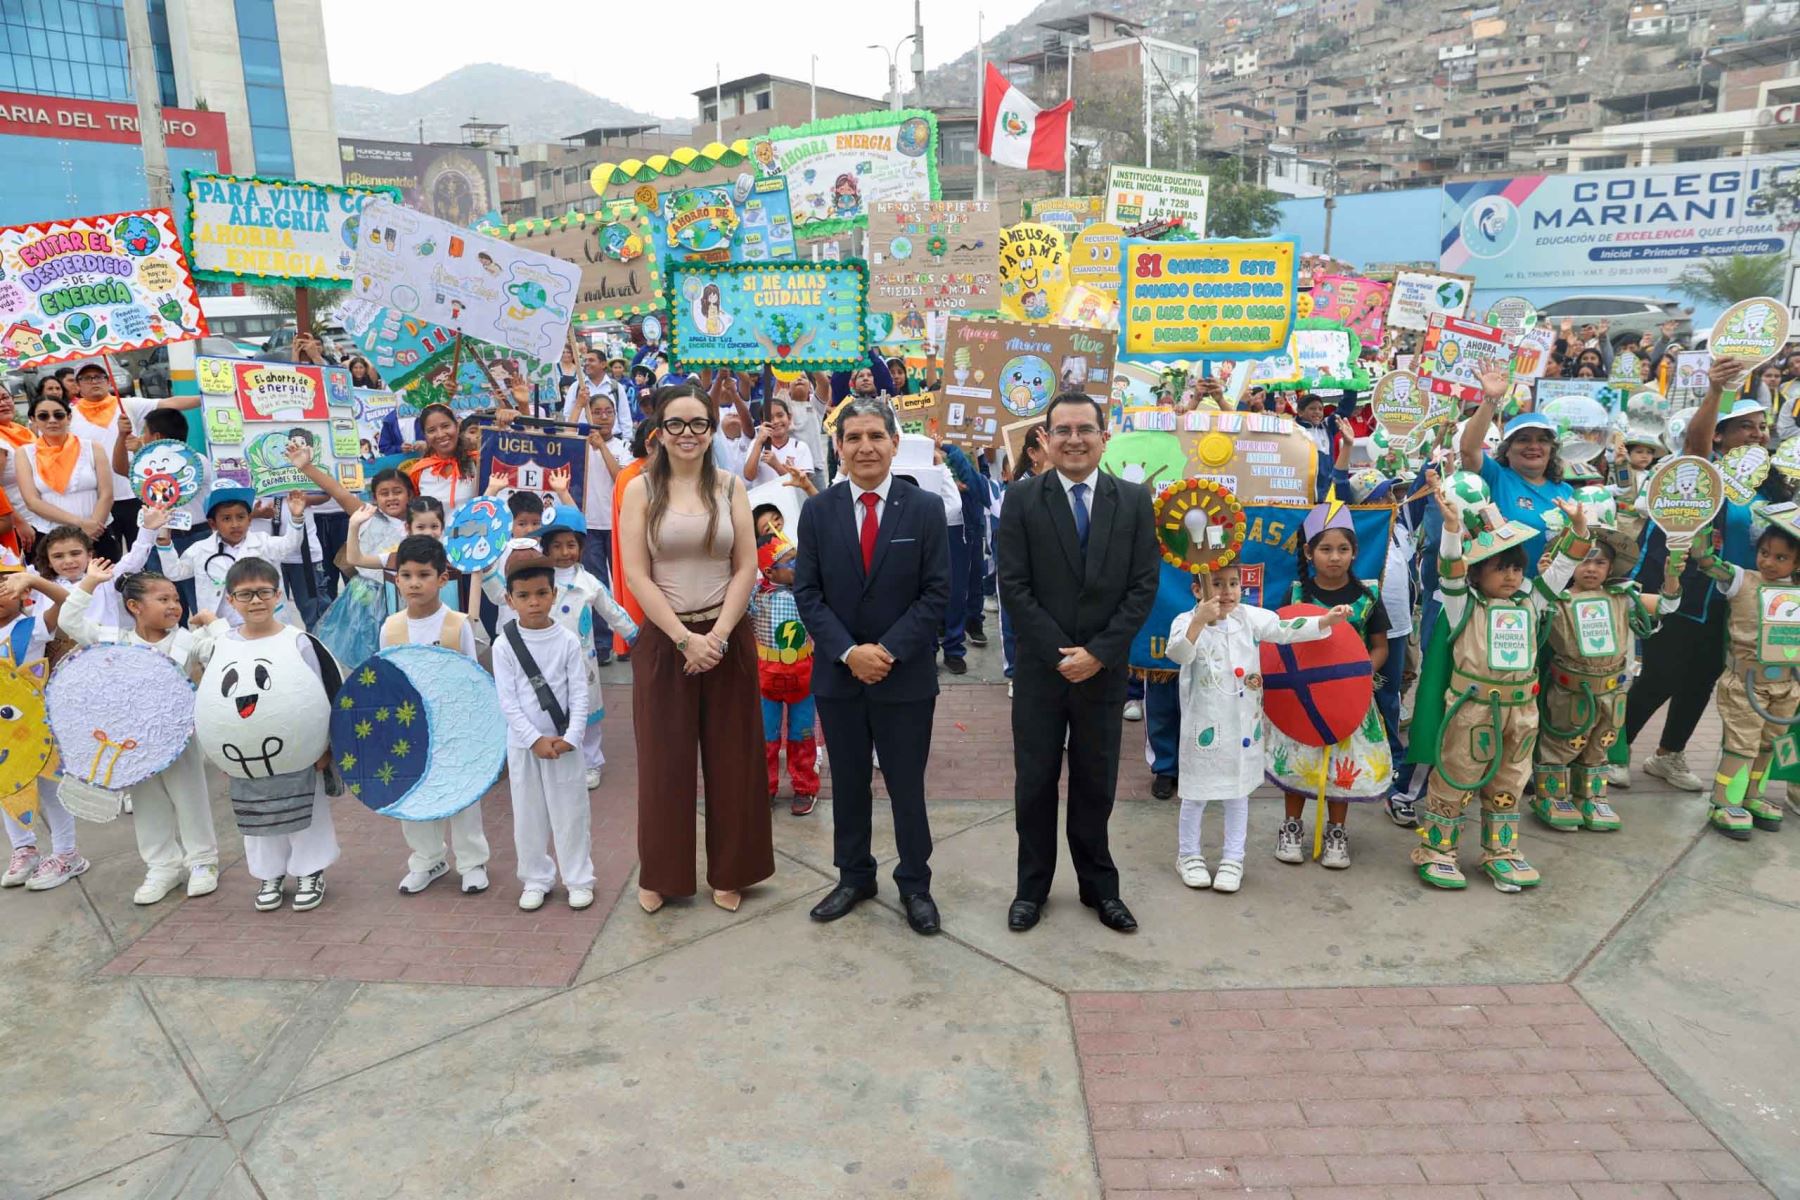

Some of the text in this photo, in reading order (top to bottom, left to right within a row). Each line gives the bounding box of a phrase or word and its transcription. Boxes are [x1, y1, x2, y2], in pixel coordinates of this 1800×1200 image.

[57, 110, 101, 129] DEL
[780, 139, 829, 171] AHORRA
[835, 134, 893, 151] ENERGIA
[767, 166, 783, 177] Luz
[1116, 170, 1203, 187] INSTITUCIÓN EDUCATIVA
[1112, 179, 1135, 190] NIVEL
[1136, 181, 1164, 193] INICIAL
[1169, 185, 1205, 197] PRIMARIA
[197, 181, 260, 207] PARA
[268, 187, 330, 213] VIVIR
[1171, 198, 1190, 209] 7258
[877, 202, 991, 213] MENOS CORRIENTE
[1118, 207, 1141, 215] 7258
[1148, 207, 1199, 221] LAS PALMAS
[228, 204, 330, 233] ALEGRIA
[672, 207, 730, 233] AHORRO DE
[200, 222, 297, 250] AHORRA
[1007, 228, 1026, 243] ME
[1024, 227, 1058, 248] USAS
[1084, 235, 1120, 243] RECUERDA
[1535, 232, 1596, 246] EDUCACIÓN
[1597, 233, 1613, 243] DE
[1615, 227, 1696, 242] EXCELENCIA
[1699, 226, 1726, 238] QUE
[1727, 224, 1774, 236] FORMA
[19, 231, 113, 268] EVITAR EL
[1599, 248, 1633, 259] Inicial
[1641, 247, 1690, 258] Primaria
[226, 248, 329, 275] ENERGIA
[999, 243, 1063, 280] PAGAME
[1135, 253, 1277, 278] SI QUIERES ESTE
[21, 254, 134, 293] DESPERDICIO
[71, 274, 85, 285] DE
[742, 274, 828, 292] SI ME AMAS
[1135, 282, 1190, 299] MUNDO
[40, 276, 133, 317] ENERGÍA
[753, 290, 823, 307] CUIDAME
[1132, 304, 1286, 322] LA LUZ QUE NO USAS
[1153, 326, 1272, 343] DEBES APAGAR
[1714, 335, 1776, 348] Ahorremos
[1068, 333, 1105, 354] Vive
[1466, 341, 1498, 354] AHORRA
[265, 372, 297, 385] ahorro
[298, 376, 309, 386] de
[258, 383, 308, 395] energía
[904, 396, 932, 408] energía
[1376, 402, 1423, 414] Ahorremos
[498, 437, 562, 457] UGEL 01
[261, 475, 292, 488] GRANDES
[524, 470, 537, 488] E
[1653, 496, 1712, 510] Ahorremos
[1663, 507, 1701, 518] energía
[1246, 571, 1257, 582] E
[1580, 621, 1609, 631] AHORRA
[1582, 629, 1611, 639] ENERGÍA
[1494, 632, 1526, 641] AHORRA
[1493, 641, 1526, 650] ENERGÍA
